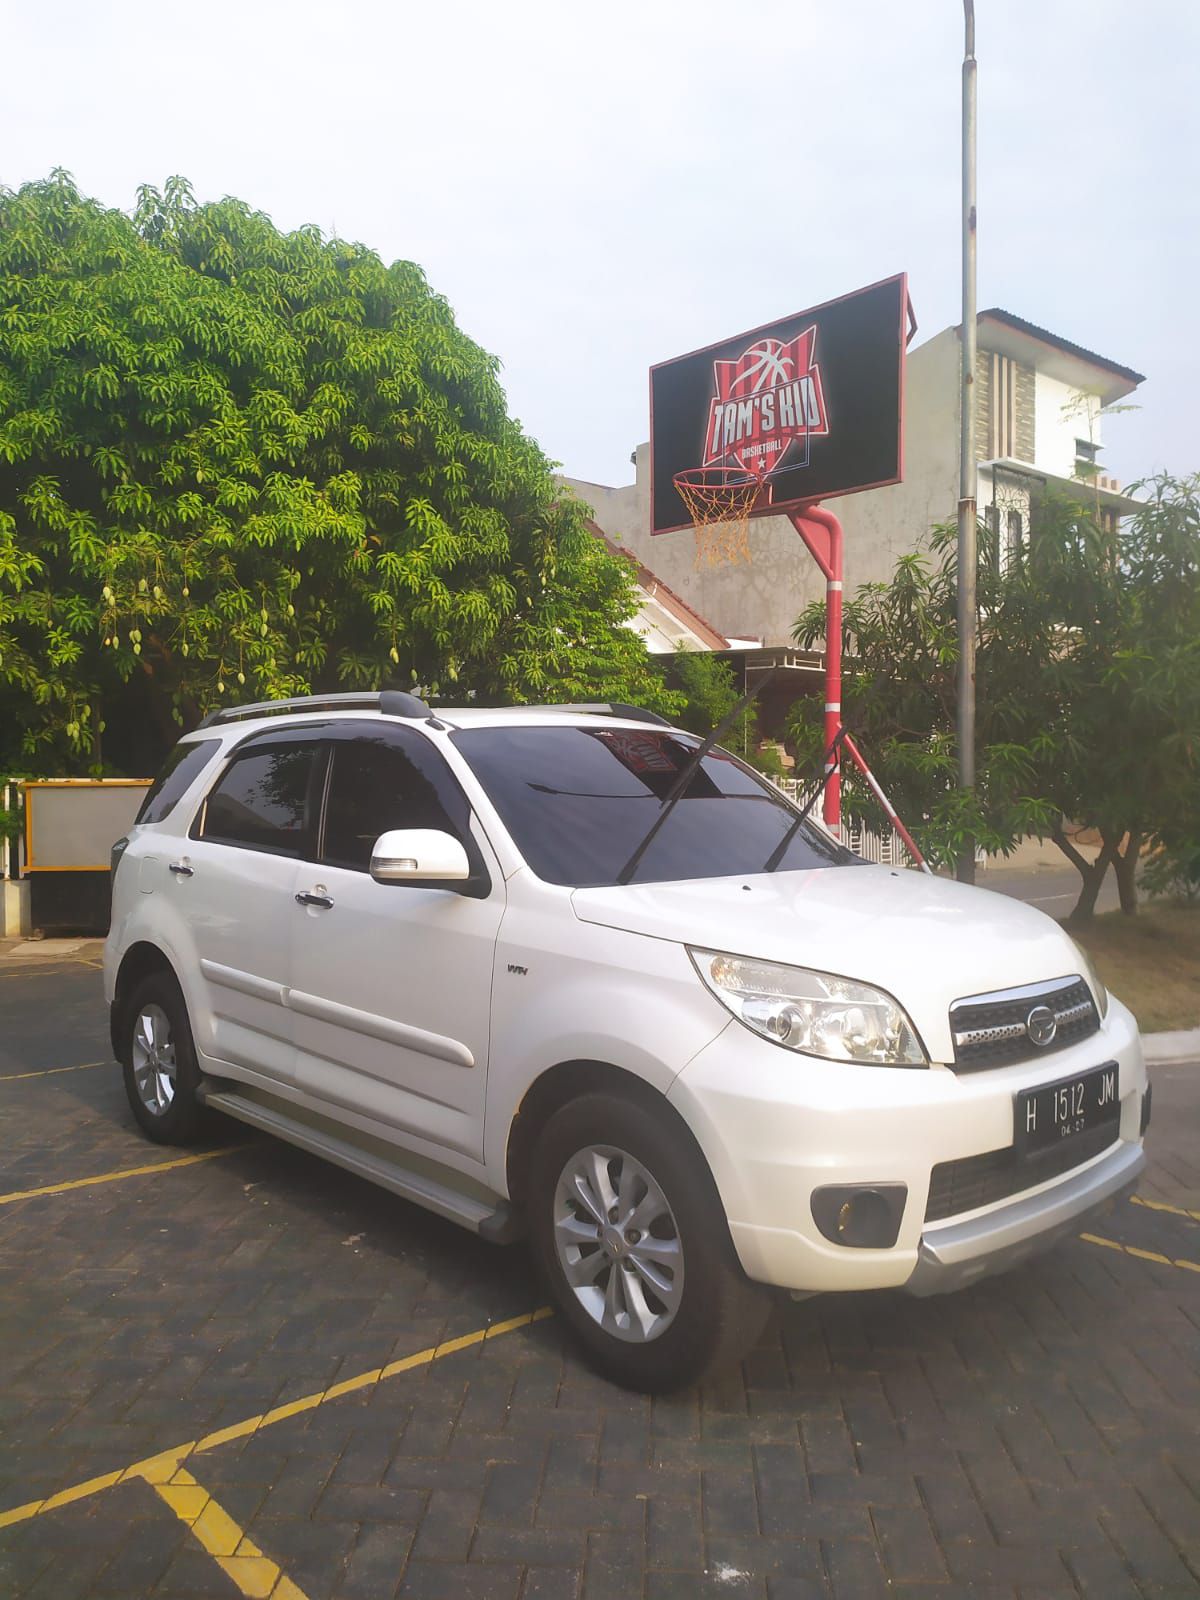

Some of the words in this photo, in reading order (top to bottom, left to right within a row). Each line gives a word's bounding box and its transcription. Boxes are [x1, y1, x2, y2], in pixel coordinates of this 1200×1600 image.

[711, 393, 775, 454] TAM'S
[779, 376, 820, 427] KID
[741, 439, 782, 459] BASKETBALL
[1026, 1098, 1037, 1133] H
[1054, 1083, 1085, 1124] 1512
[1097, 1072, 1115, 1106] JM
